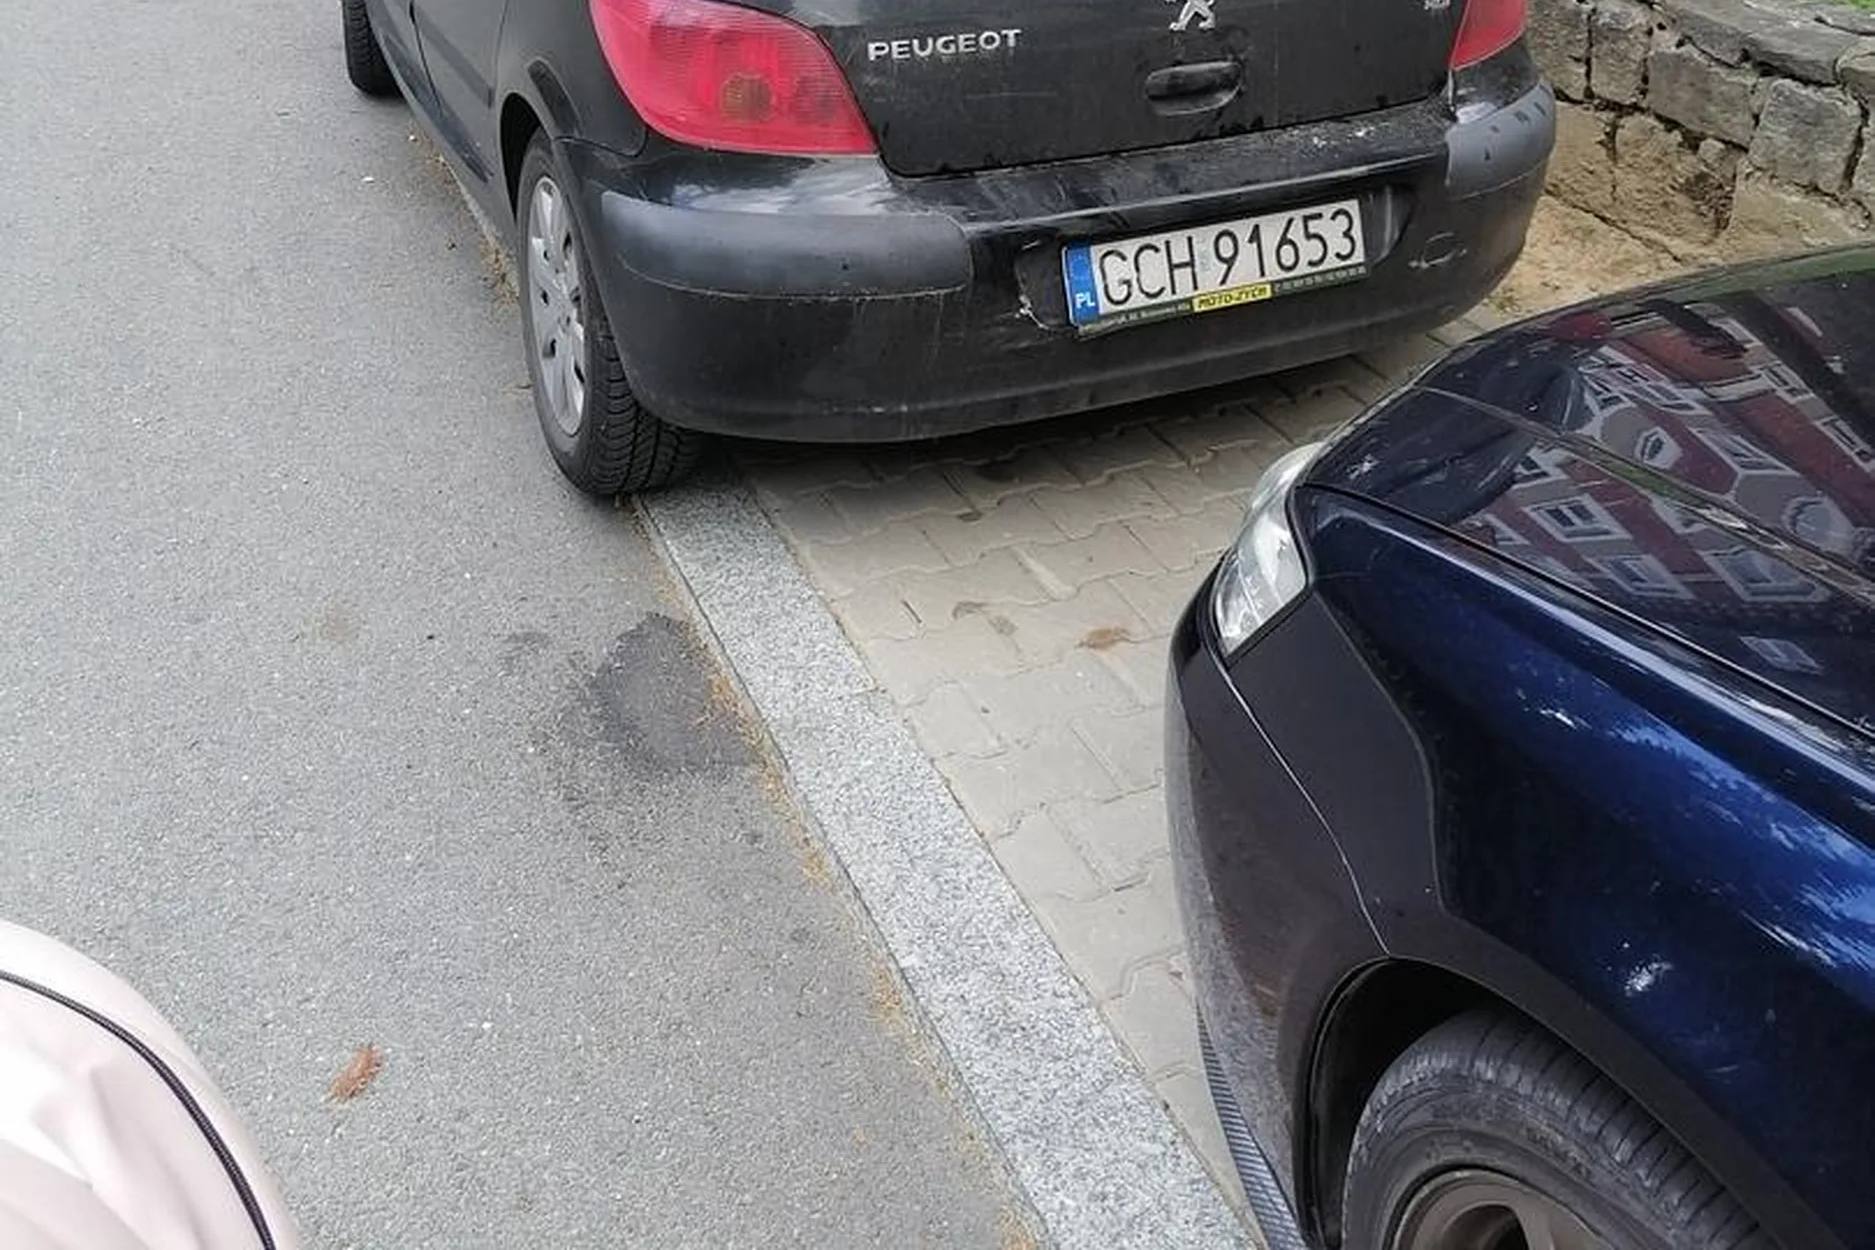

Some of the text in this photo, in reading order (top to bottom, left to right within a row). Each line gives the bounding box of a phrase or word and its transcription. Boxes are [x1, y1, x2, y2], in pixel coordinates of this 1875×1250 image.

[867, 28, 1022, 61] PEUGEOT
[1099, 207, 1358, 306] GCH 91653
[1075, 291, 1096, 309] PL
